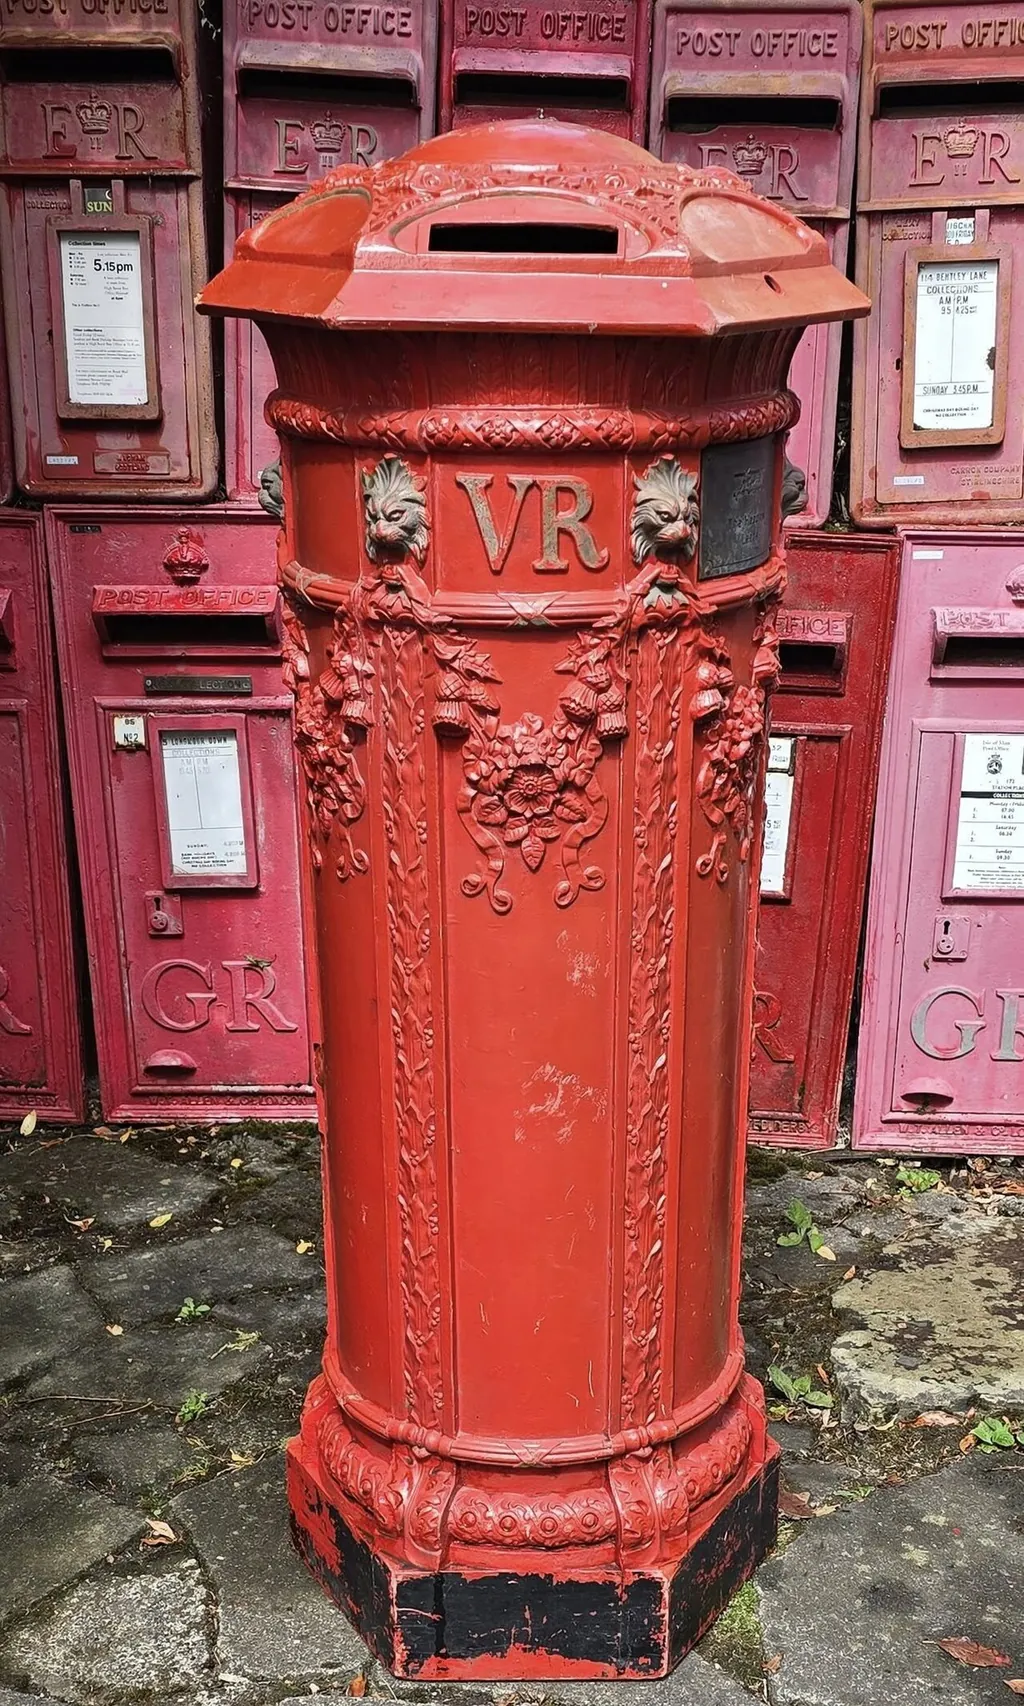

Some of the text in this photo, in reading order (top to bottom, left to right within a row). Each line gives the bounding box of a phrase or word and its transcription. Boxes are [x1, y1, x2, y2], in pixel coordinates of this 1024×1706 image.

[248, 0, 412, 38] POST OFFICE
[464, 5, 627, 42] POST OFFICE
[676, 28, 839, 58] POST OFFICE
[885, 21, 948, 52] POST
[86, 201, 113, 213] SUN
[455, 471, 610, 575] VR
[100, 588, 271, 606] POST OFFICE
[942, 611, 1010, 628] POST
[141, 958, 299, 1034] GR
